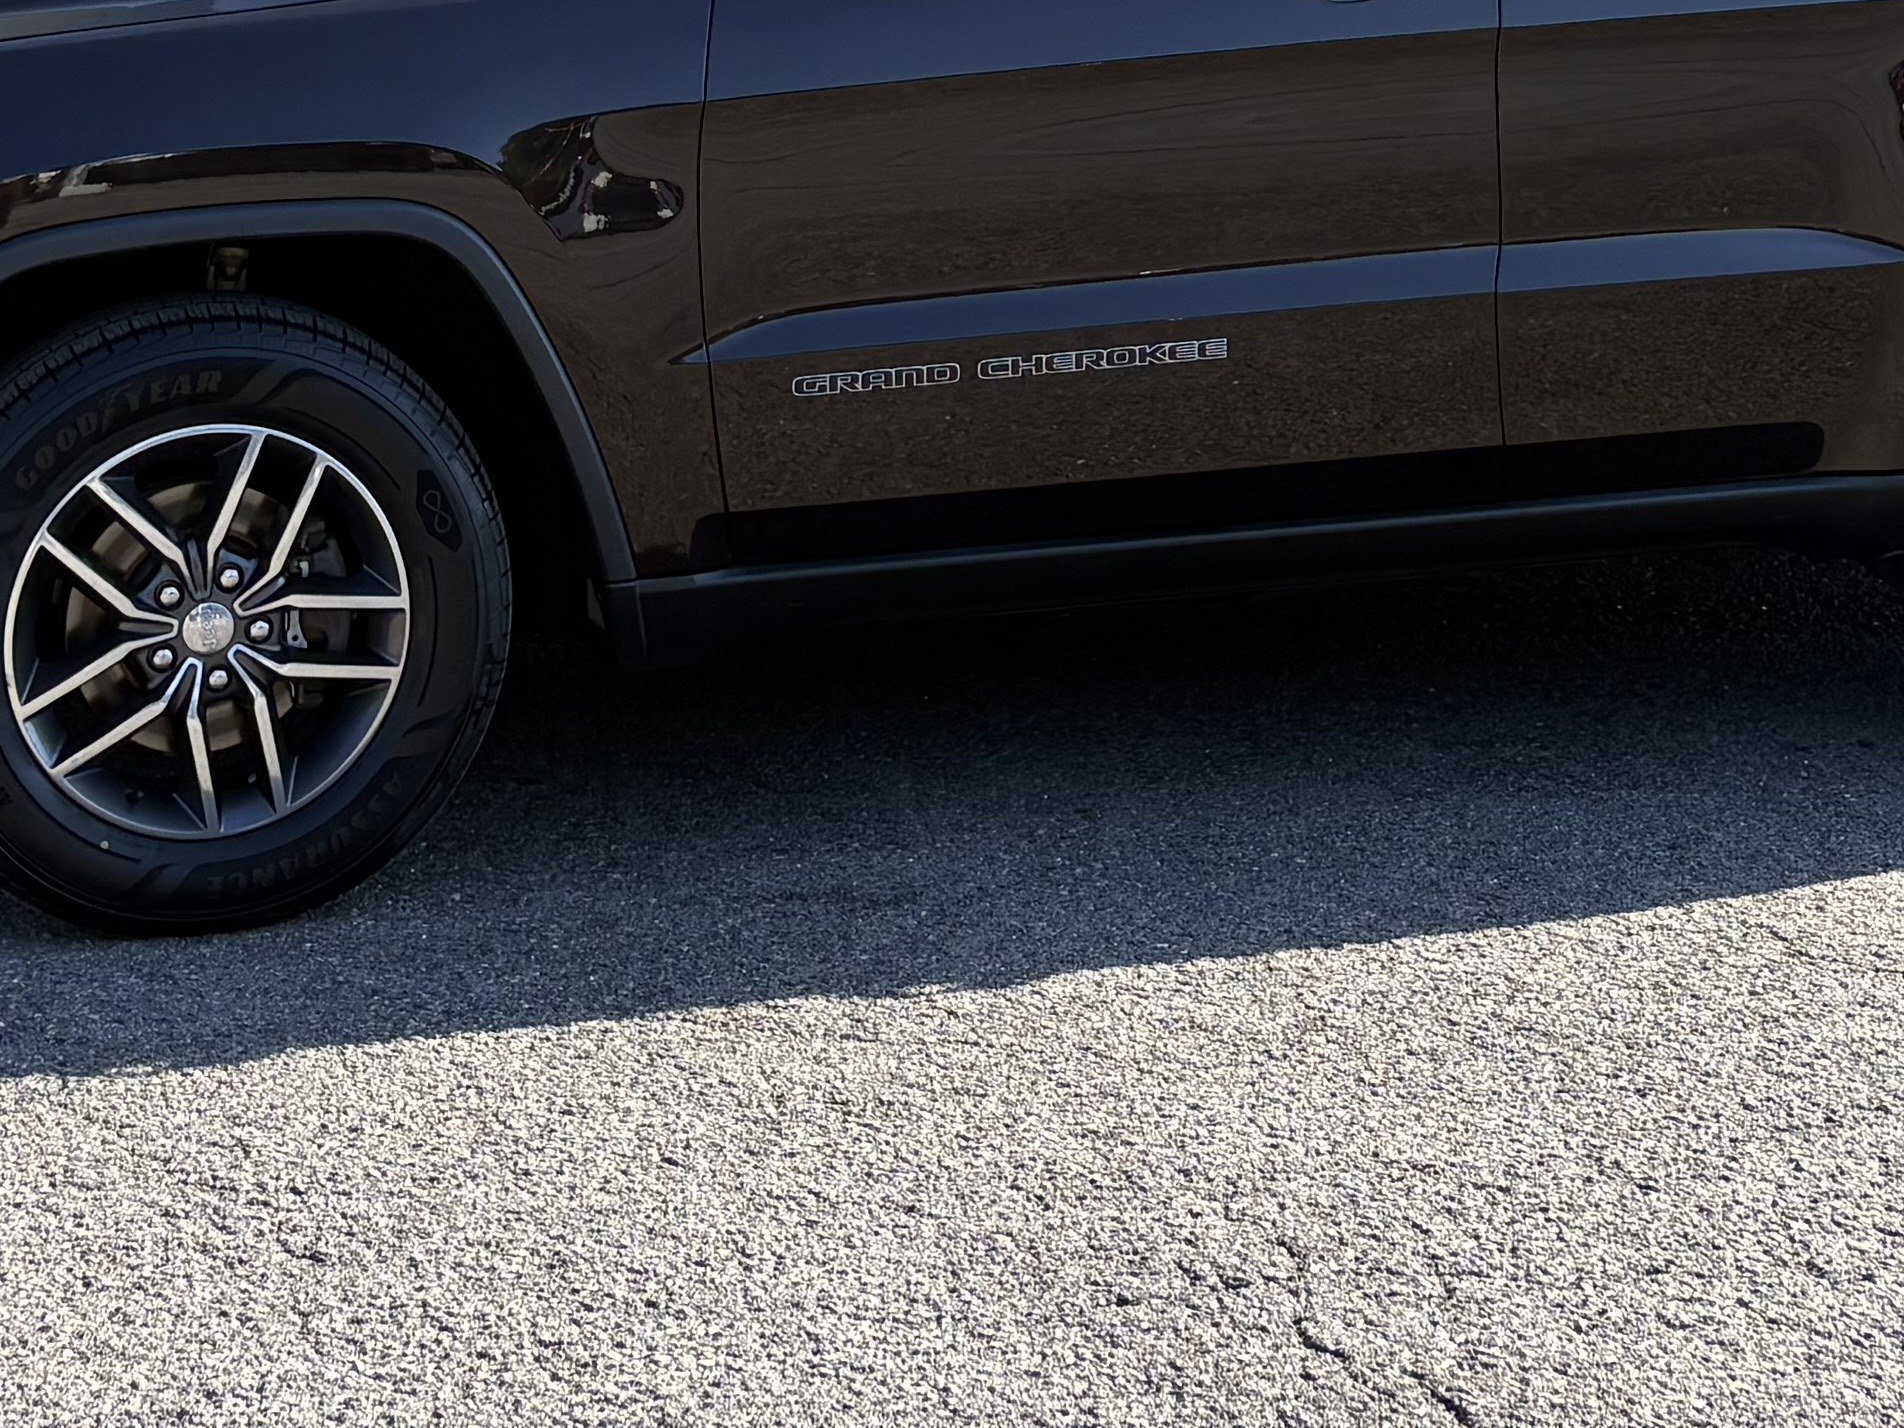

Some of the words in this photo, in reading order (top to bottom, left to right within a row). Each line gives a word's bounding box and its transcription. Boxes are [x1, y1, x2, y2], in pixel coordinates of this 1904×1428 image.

[791, 362, 961, 397] GRAND
[977, 337, 1228, 380] CHEROKEE
[15, 369, 223, 490] GOODYEAR
